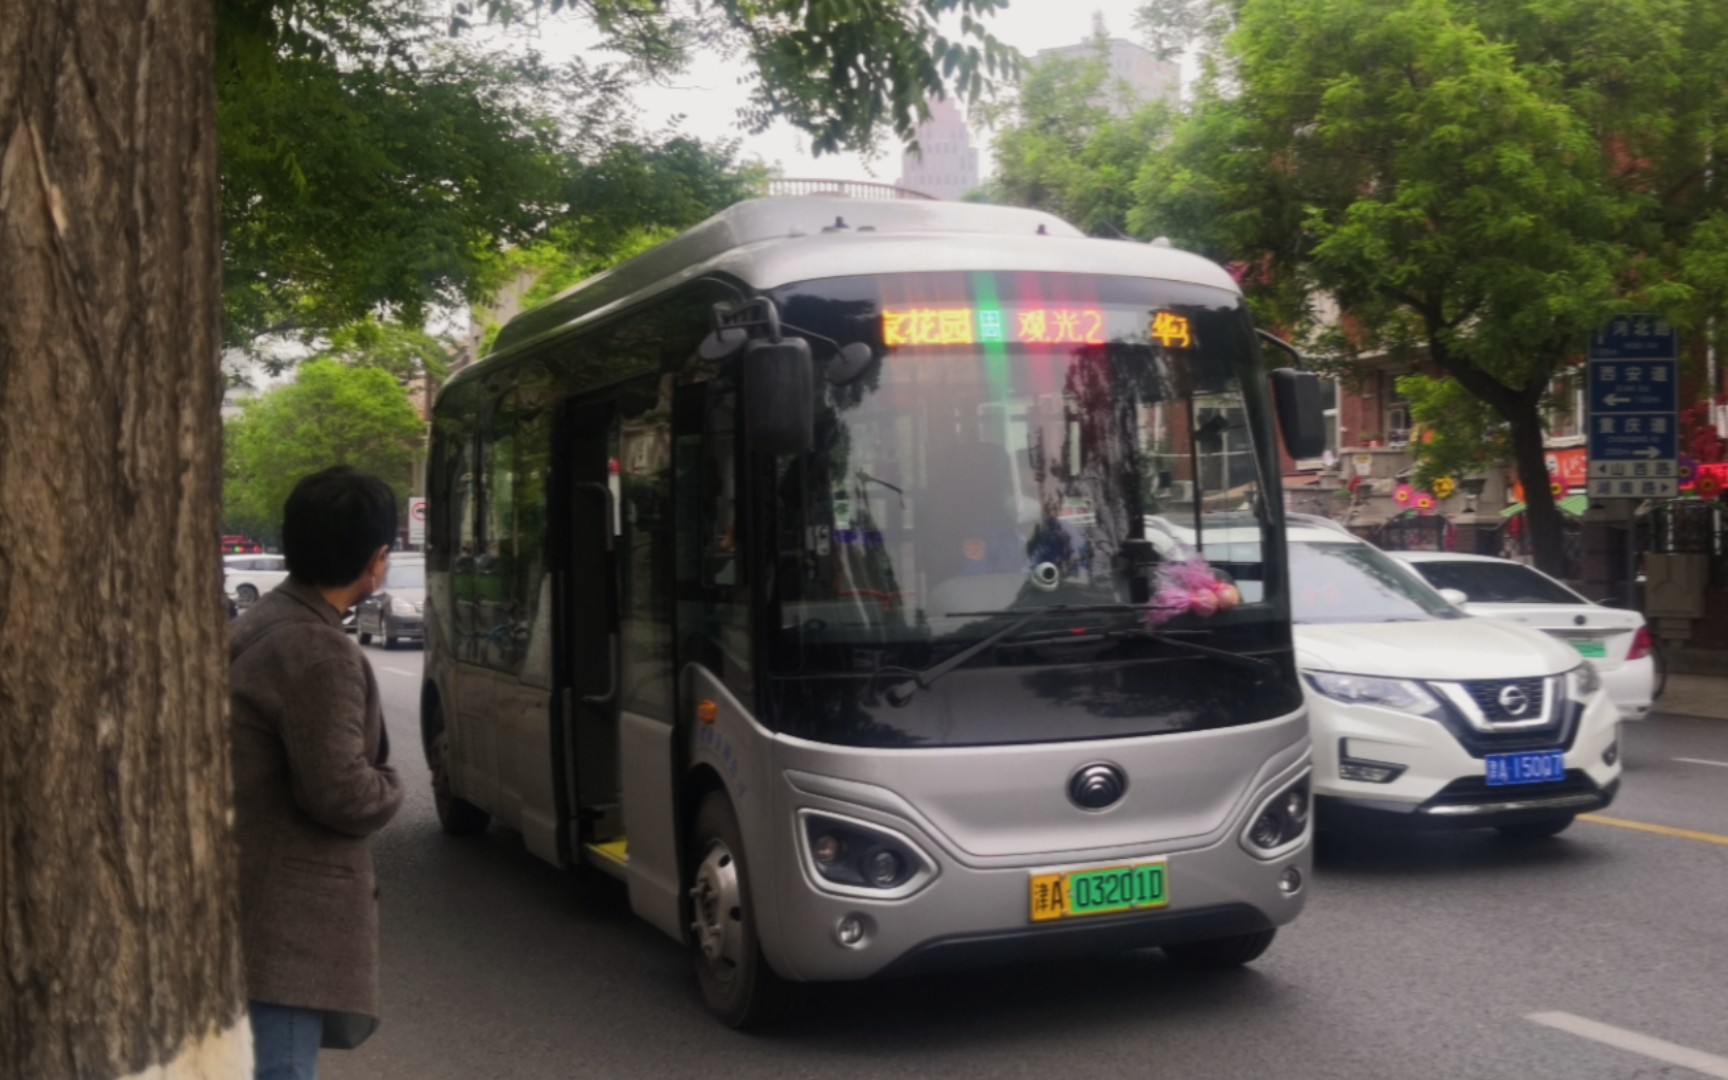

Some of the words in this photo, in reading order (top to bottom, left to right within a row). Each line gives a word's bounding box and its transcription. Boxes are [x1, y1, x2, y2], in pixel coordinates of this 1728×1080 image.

[1018, 309, 1105, 345] 观光2
[1600, 366, 1669, 382] 西安道
[1599, 417, 1668, 434] 重庆道
[1611, 462, 1670, 476] 山西路
